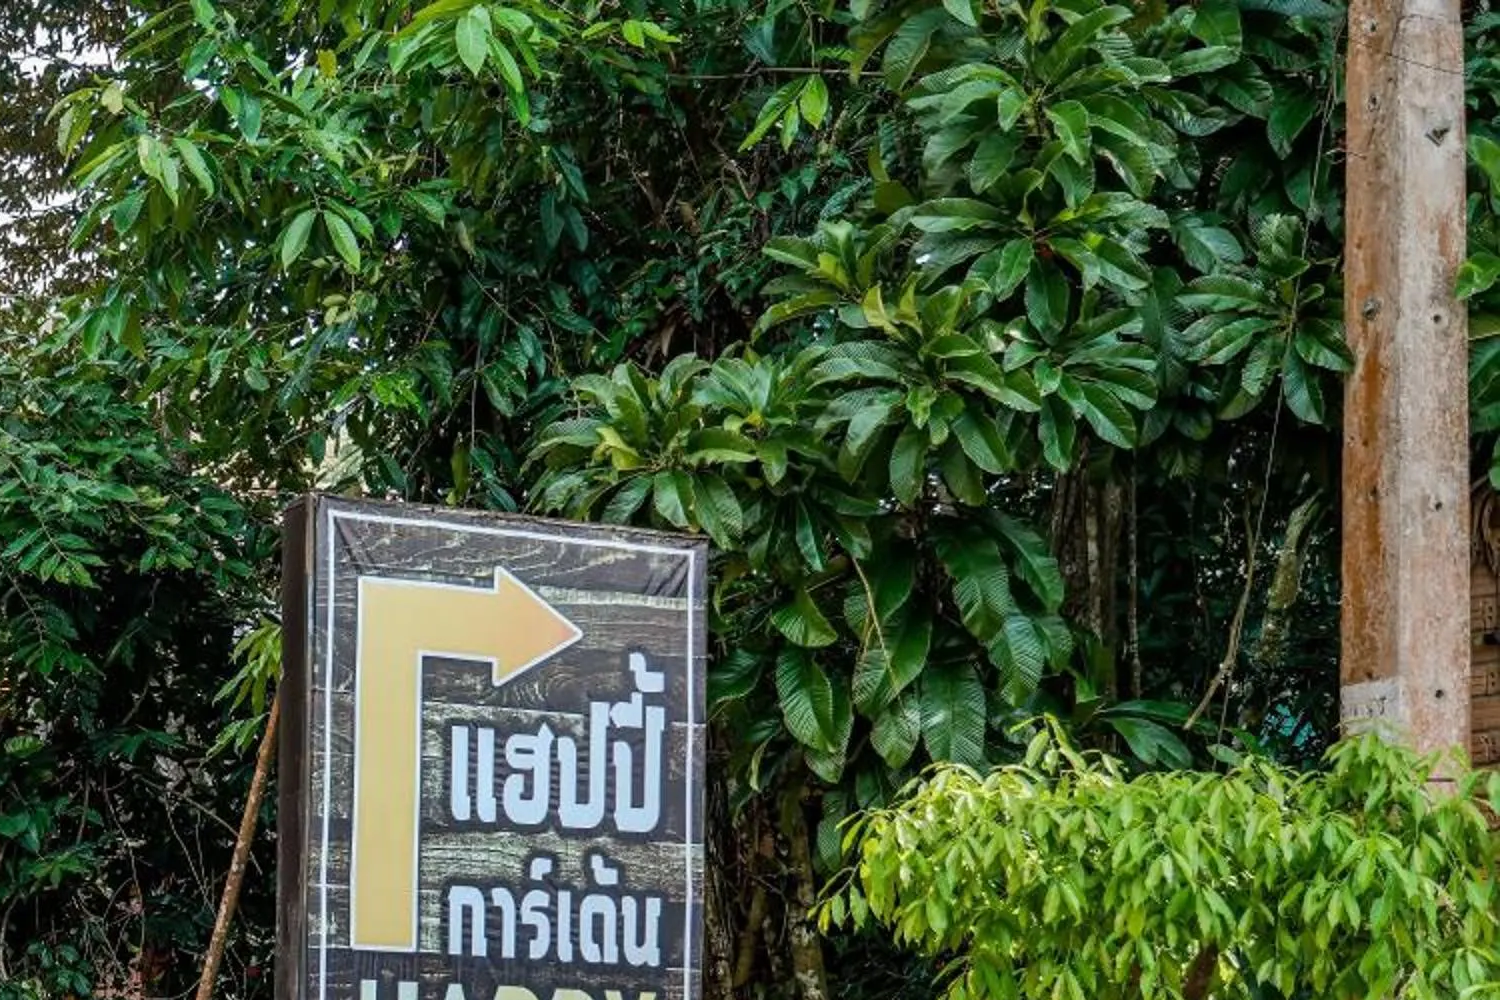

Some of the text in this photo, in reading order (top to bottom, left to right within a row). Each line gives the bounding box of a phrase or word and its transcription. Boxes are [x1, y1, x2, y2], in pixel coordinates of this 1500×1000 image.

[451, 651, 666, 833] แฮปปี้
[448, 854, 662, 967] การ์เด้น
